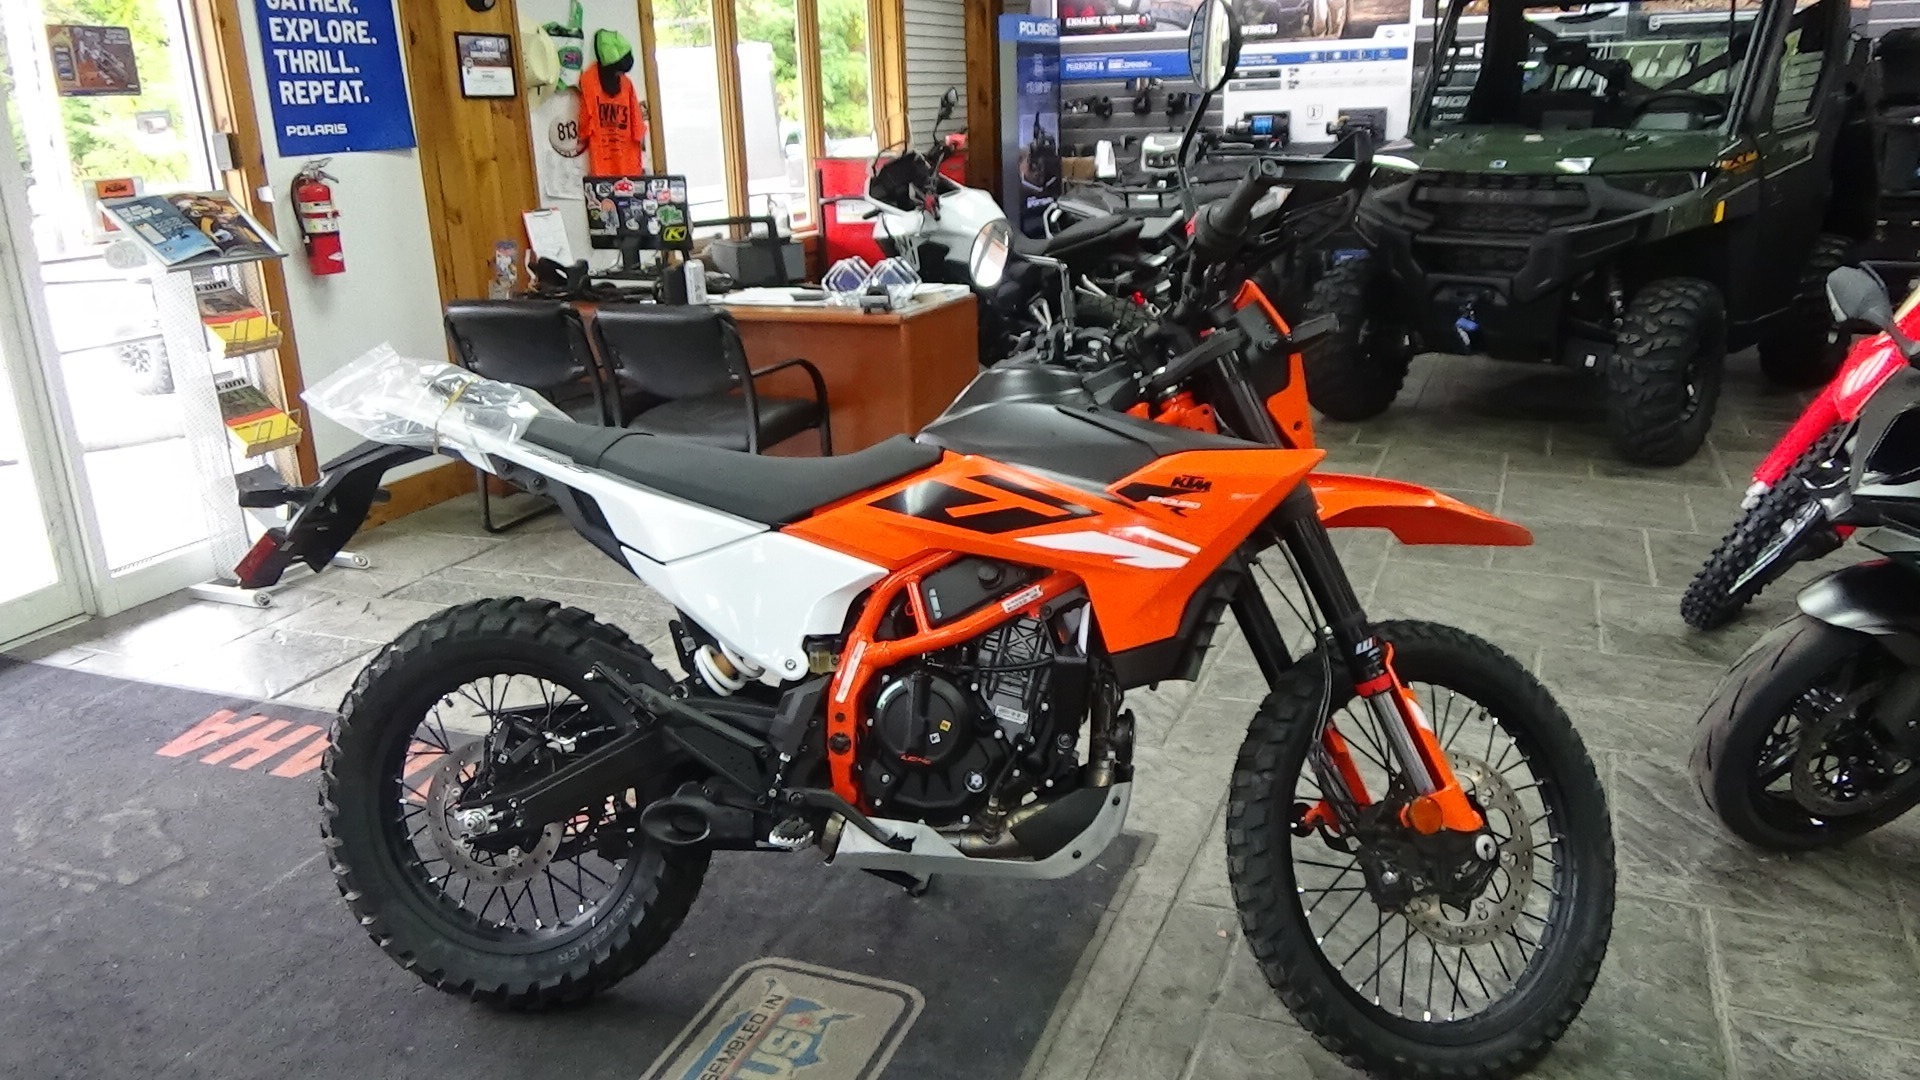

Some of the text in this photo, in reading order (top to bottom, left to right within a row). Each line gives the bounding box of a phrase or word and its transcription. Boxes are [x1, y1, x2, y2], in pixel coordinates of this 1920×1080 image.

[269, 17, 377, 44] EXPLORE.
[1019, 21, 1057, 36] POLARIS
[273, 49, 360, 74] THRILL.
[278, 80, 370, 105] REPEAT.
[286, 123, 348, 137] POLARIS
[557, 121, 578, 141] 813
[1171, 475, 1212, 492] KTM
[762, 993, 784, 1010] IN
